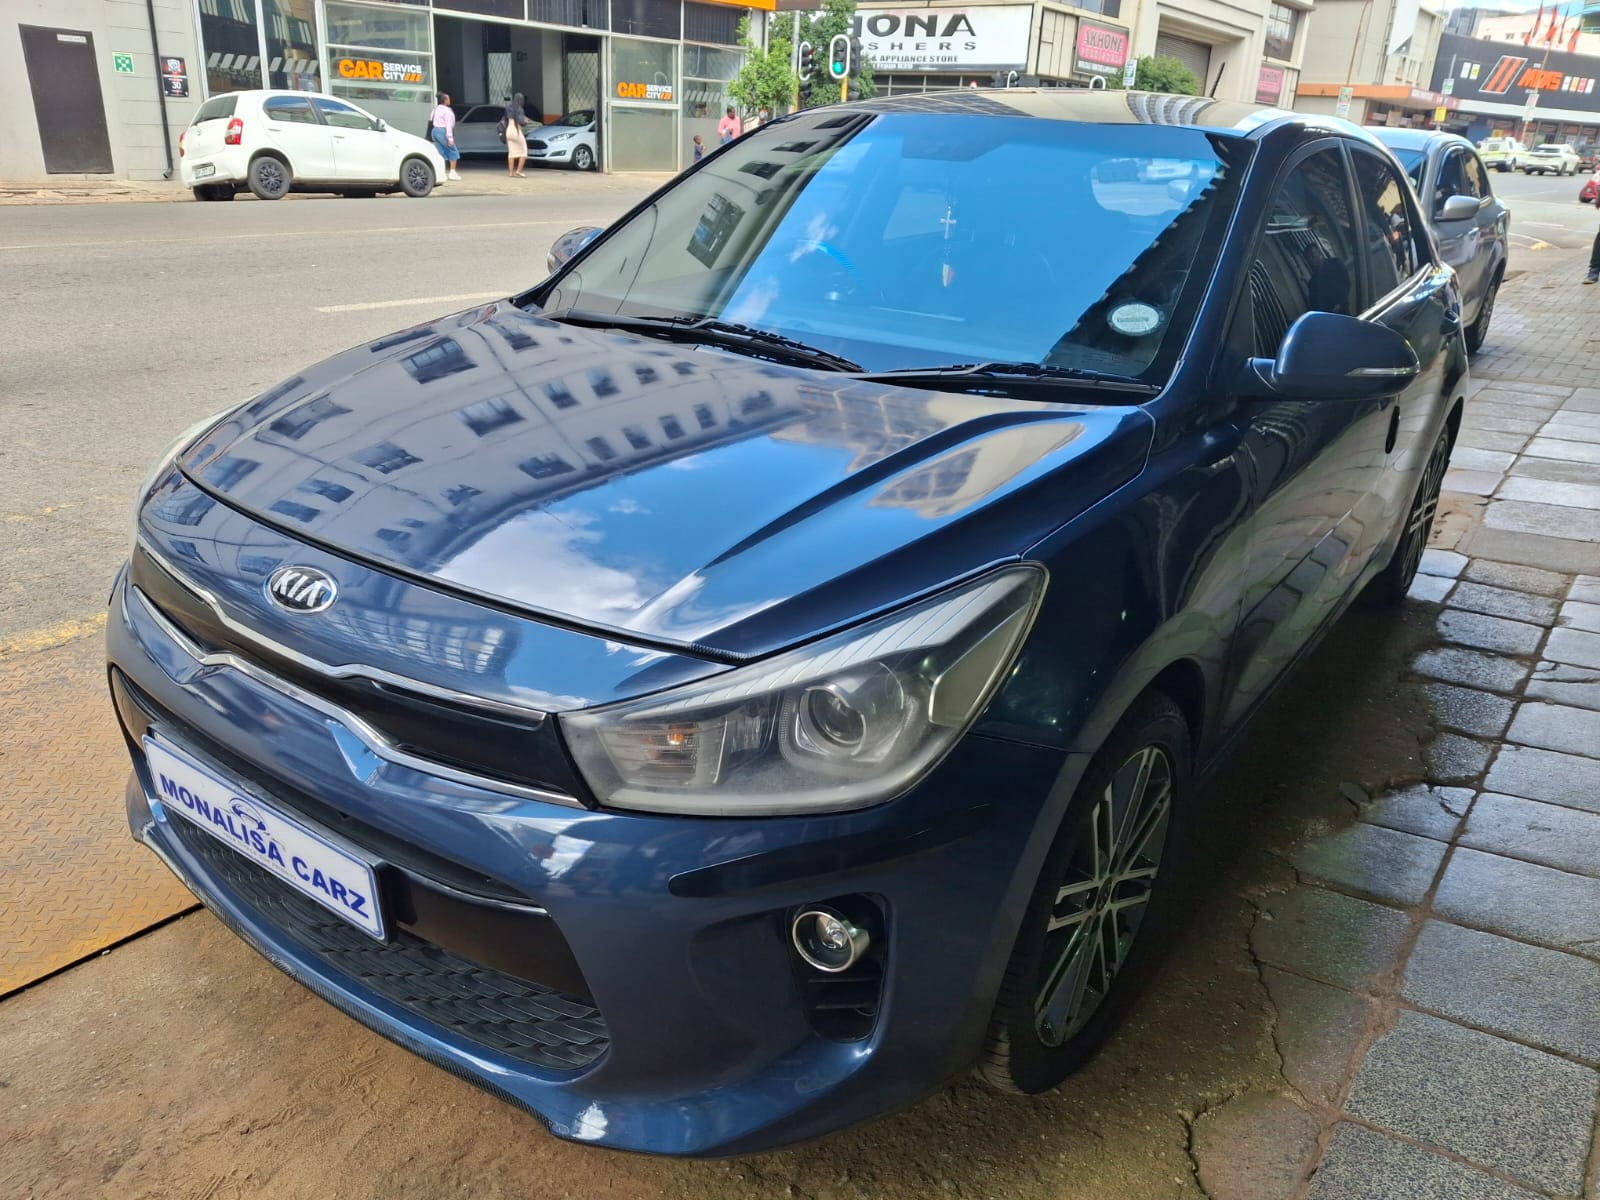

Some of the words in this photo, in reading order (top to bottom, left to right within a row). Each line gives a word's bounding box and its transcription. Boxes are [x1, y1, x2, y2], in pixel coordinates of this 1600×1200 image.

[880, 55, 926, 63] APPLIANCE
[929, 55, 958, 63] STORE
[338, 58, 383, 79] CAR
[383, 62, 422, 74] SERVICE
[383, 71, 406, 81] CITY
[617, 82, 646, 98] CAR
[646, 84, 672, 92] SERVICE
[272, 569, 324, 608] KIA
[159, 773, 286, 868] MONALISA
[291, 855, 370, 920] CARZ
